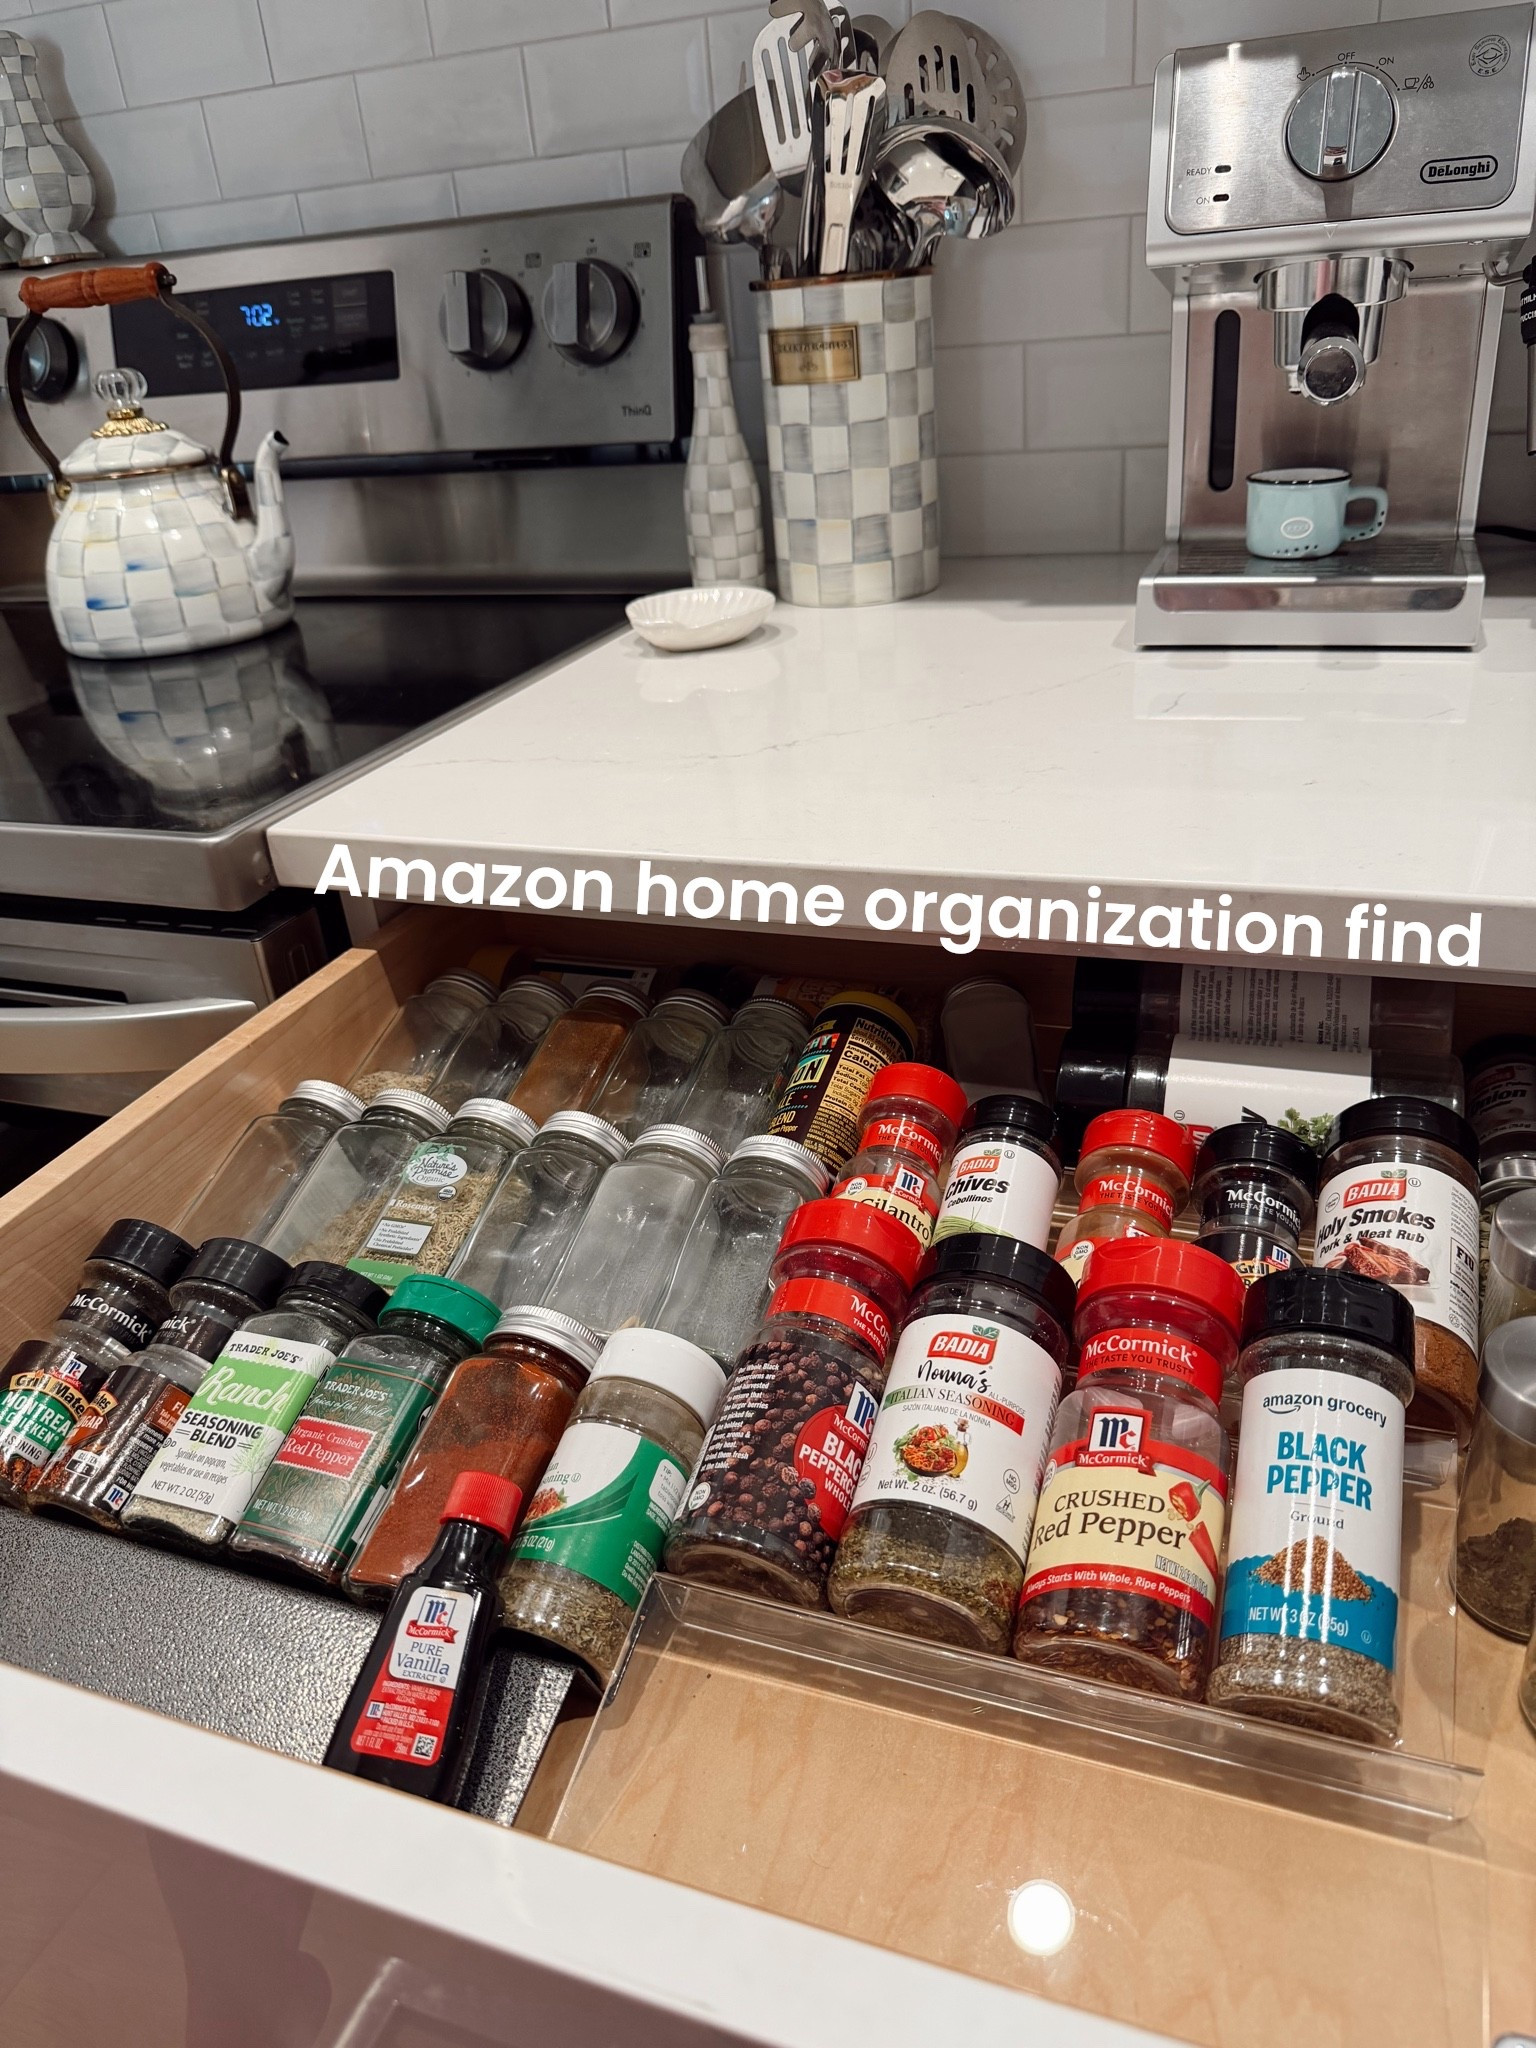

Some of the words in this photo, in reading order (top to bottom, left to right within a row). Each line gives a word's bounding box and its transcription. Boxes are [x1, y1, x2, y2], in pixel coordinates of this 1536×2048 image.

[1338, 52, 1355, 62] OFF
[1378, 56, 1394, 67] ON
[1186, 166, 1212, 176] READY
[1196, 195, 1210, 205] ON
[622, 405, 652, 416] ThinQ
[851, 1034, 873, 1047] Serving
[856, 1020, 895, 1047] Nutrition
[844, 1050, 880, 1072] Calori
[836, 1071, 858, 1082] Sodium
[878, 1124, 942, 1162] McCormic
[411, 1166, 459, 1178] Promise
[421, 1156, 458, 1171] Nature's
[960, 1158, 995, 1173] BADIA
[416, 1174, 445, 1183] Organic
[945, 1175, 1011, 1201] Chives
[1347, 1182, 1400, 1201] BADIA
[396, 1200, 437, 1212] Rosemary
[1144, 1199, 1158, 1211] YOU
[1226, 1189, 1300, 1230] McCormic
[1318, 1216, 1347, 1249] Holy
[1350, 1207, 1435, 1230] Smokes
[1320, 1239, 1340, 1258] Pork
[1343, 1234, 1352, 1244] &
[1357, 1229, 1391, 1241] Meat
[1396, 1229, 1425, 1244] Rub
[70, 1294, 148, 1343] McCormick
[850, 1295, 890, 1347] McCor
[853, 1317, 866, 1330] THE
[867, 1328, 881, 1347] TASTE
[230, 1344, 270, 1356] TRADER
[271, 1350, 300, 1364] JOE'S
[932, 1336, 990, 1360] BADIA
[1086, 1335, 1194, 1370] McCormick
[1086, 1360, 1098, 1369] THE
[1100, 1354, 1128, 1364] TASTE
[1131, 1354, 1153, 1363] YOU
[917, 1359, 992, 1394] Nonna's
[53, 1384, 85, 1416] Mate
[196, 1365, 290, 1412] Ranch
[324, 1381, 359, 1395] TRADER
[360, 1388, 388, 1401] JOE'S
[2, 1390, 71, 1437] MONTREA
[732, 1403, 746, 1411] larger
[890, 1388, 936, 1404] ITALIAN
[938, 1389, 1015, 1427] SEASONING
[902, 1403, 921, 1412] SAZÓN
[921, 1404, 948, 1413] ITALIANO
[960, 1410, 968, 1420] LA
[969, 1414, 991, 1428] NONNA
[988, 1392, 1026, 1416] ALL-PURPOSE
[1262, 1393, 1324, 1408] amazon
[1327, 1395, 1387, 1429] grocery
[182, 1411, 264, 1439] SEASONING
[724, 1421, 743, 1429] boldest
[727, 1412, 744, 1420] picked
[190, 1429, 237, 1449] BLEND
[292, 1425, 325, 1441] Organic
[327, 1433, 364, 1449] Crushed
[175, 1448, 197, 1462] Sprinkle
[197, 1454, 204, 1462] on
[204, 1455, 227, 1469] popcorn,
[283, 1438, 307, 1459] Red
[308, 1442, 355, 1467] Pepper
[823, 1431, 861, 1481] BLAC
[1079, 1453, 1147, 1468] McCormick
[1277, 1431, 1368, 1473] BLACK
[160, 1462, 186, 1477] vegetables
[186, 1467, 193, 1475] or
[193, 1468, 204, 1479] use
[210, 1472, 228, 1485] recipes
[799, 1444, 856, 1499] PEPPERC
[1009, 1473, 1016, 1483] NO
[151, 1480, 165, 1491] NET
[167, 1483, 179, 1494] WT.
[179, 1486, 186, 1496] 2
[186, 1488, 195, 1498] OZ
[196, 1490, 214, 1505] (57g)
[877, 1479, 892, 1491] Net
[894, 1479, 909, 1491] Wt.
[912, 1481, 920, 1491] 2
[922, 1485, 936, 1495] oz.
[939, 1486, 967, 1504] (56.7
[967, 1494, 978, 1512] g)
[1006, 1479, 1017, 1491] MSG
[1266, 1464, 1373, 1511] PEPPER
[253, 1499, 265, 1510] NET
[278, 1503, 287, 1516] 1.2
[287, 1506, 296, 1517] OZ
[1054, 1489, 1166, 1513] CRUSHED
[1033, 1512, 1072, 1551] Red
[1079, 1512, 1186, 1549] Pepper
[527, 1536, 537, 1547] OZ
[536, 1535, 556, 1552] (21g)
[1026, 1580, 1046, 1595] Always
[1047, 1572, 1072, 1585] Starts
[1074, 1570, 1097, 1581] With
[1099, 1572, 1132, 1586] Whole,
[1135, 1576, 1157, 1590] Ripe
[1158, 1584, 1191, 1603] Peppers
[1249, 1606, 1269, 1622] NET
[1289, 1609, 1297, 1622] 3
[408, 1625, 451, 1638] McCormick
[410, 1641, 444, 1657] PURE
[397, 1653, 450, 1676] Vanilla
[402, 1669, 437, 1682] EXTRACT
